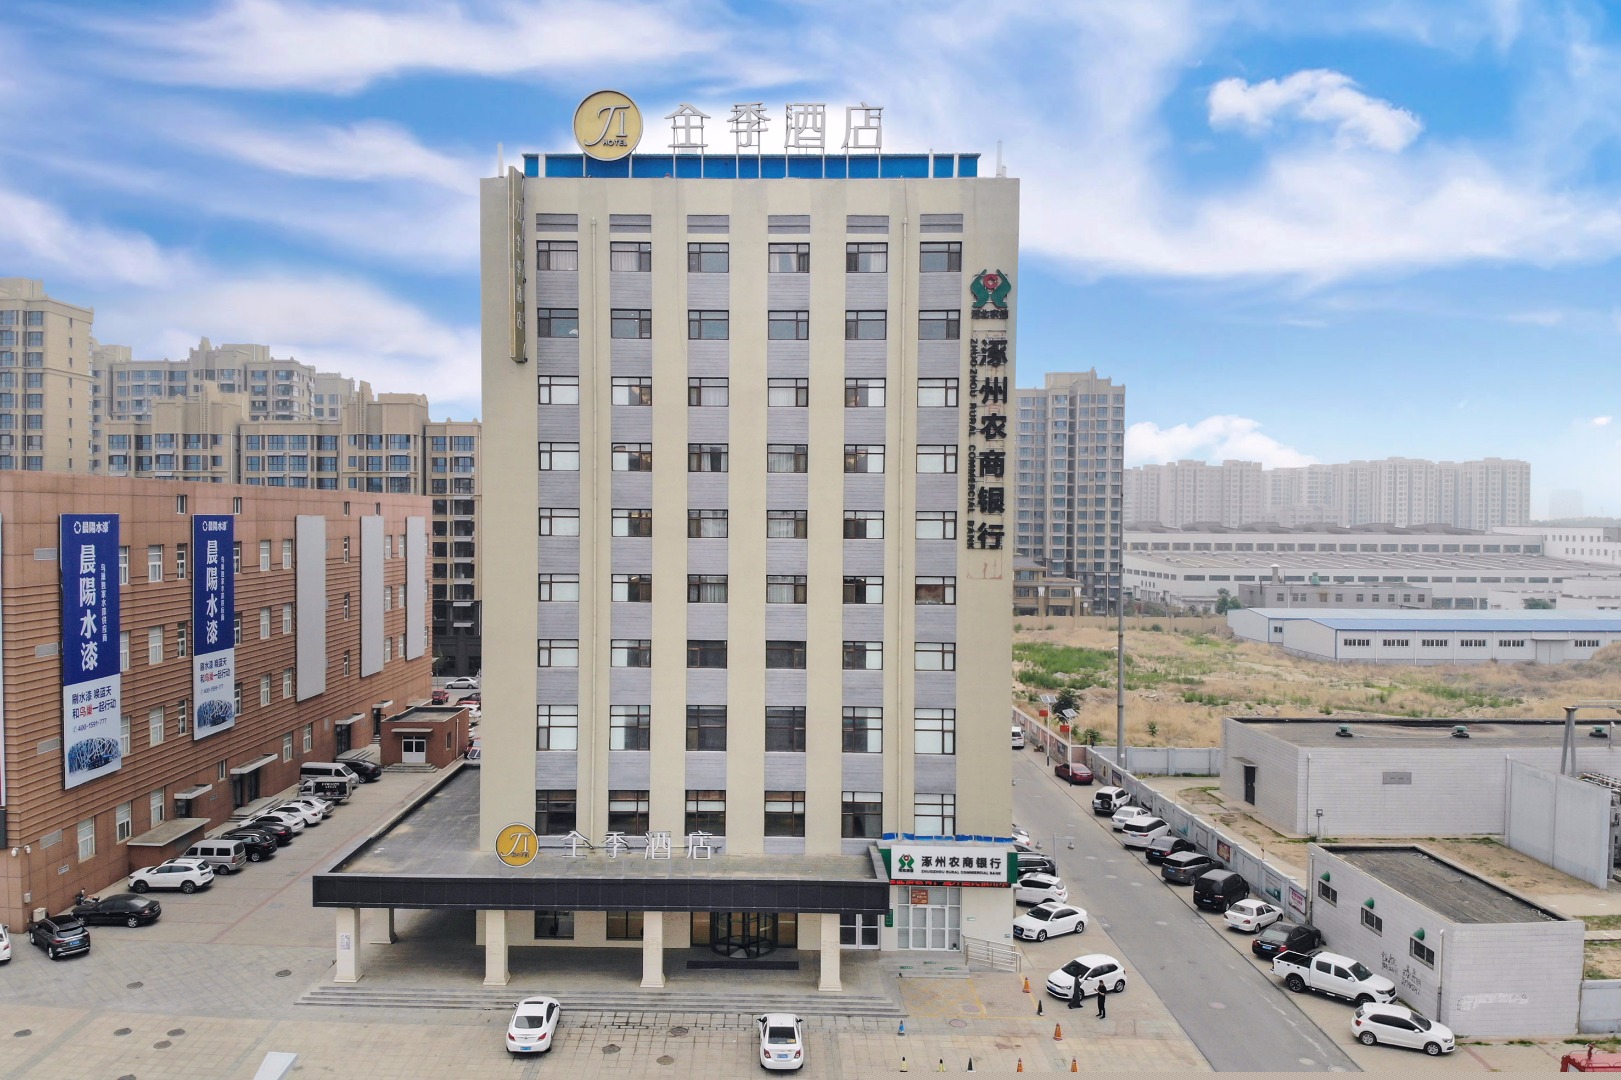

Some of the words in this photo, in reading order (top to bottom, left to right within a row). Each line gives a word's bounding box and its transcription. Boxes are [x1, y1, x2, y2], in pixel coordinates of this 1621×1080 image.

[664, 102, 885, 149] 全季酒店
[969, 402, 977, 437] RURAL
[978, 339, 1008, 549] 涿州农商银行
[968, 444, 977, 514] COMMERCIAL
[967, 520, 975, 549] BANK
[79, 544, 98, 671] 晨陽水漆
[206, 540, 218, 645] 晨陽水漆
[561, 830, 713, 860] 全季酒店
[921, 856, 1001, 869] 涿州农商银行
